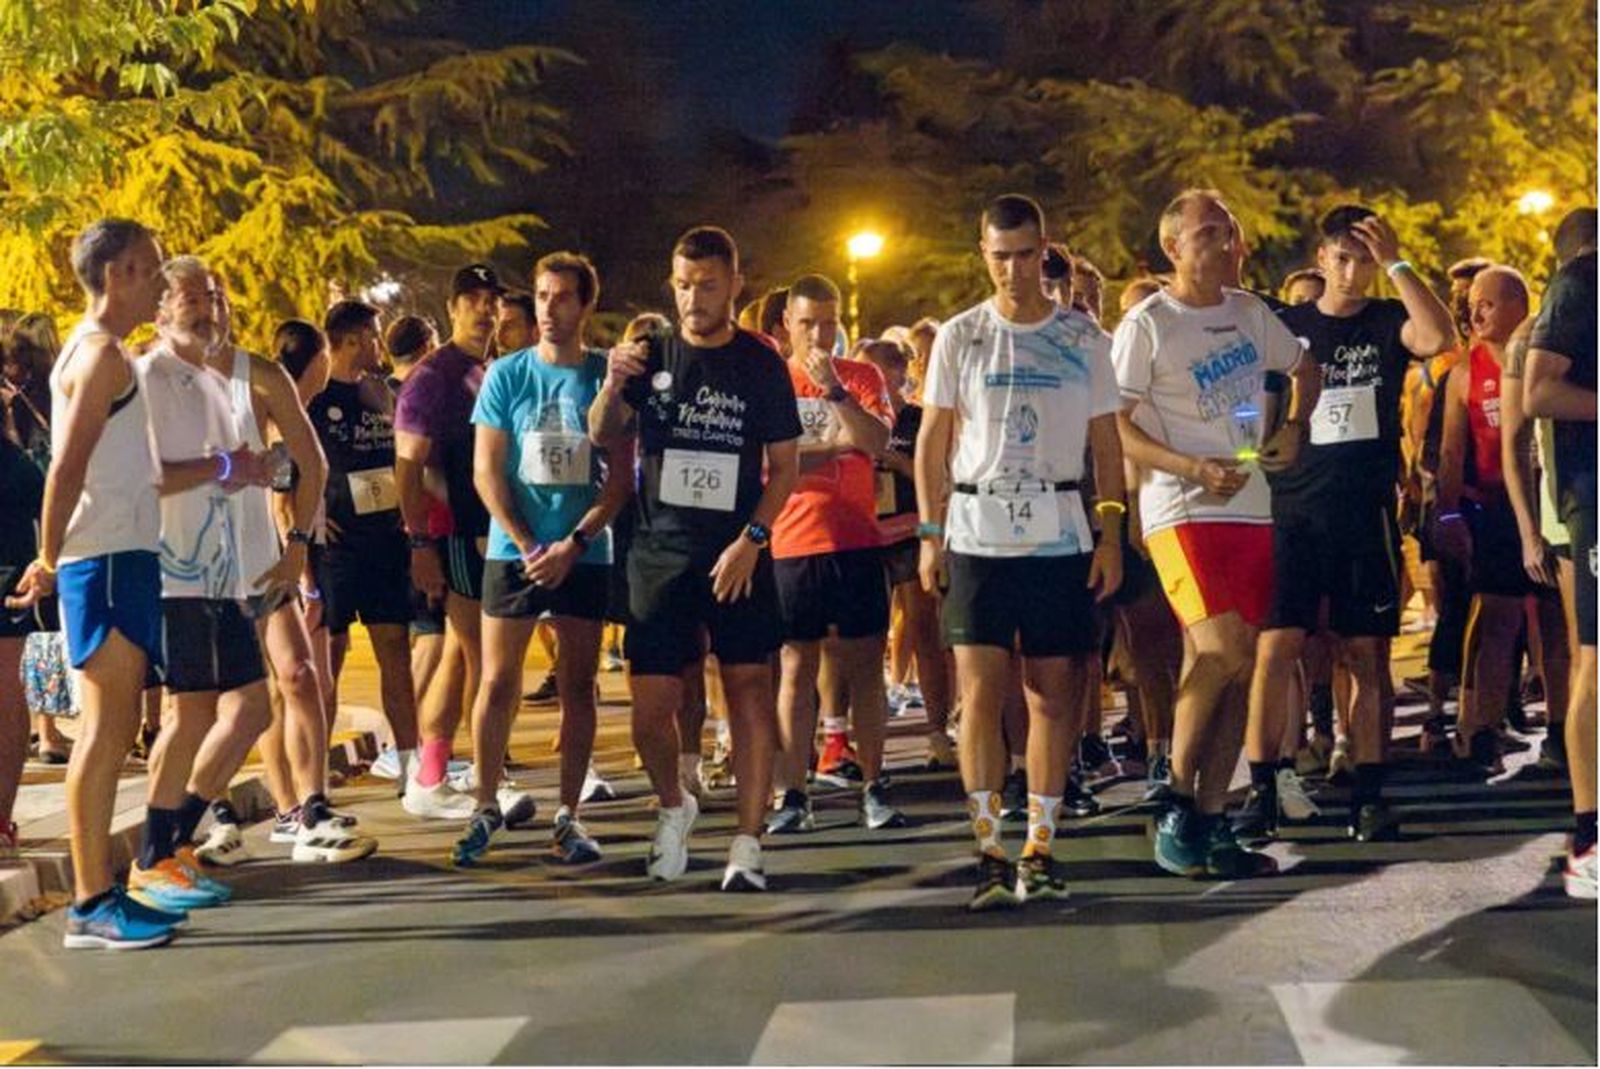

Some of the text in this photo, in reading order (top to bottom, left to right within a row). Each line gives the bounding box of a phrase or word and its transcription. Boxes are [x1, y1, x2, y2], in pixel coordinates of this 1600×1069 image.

[803, 411, 828, 429] 92
[1328, 403, 1353, 425] 57
[539, 445, 572, 467] 151
[680, 466, 721, 491] 126
[1006, 501, 1032, 523] 14
